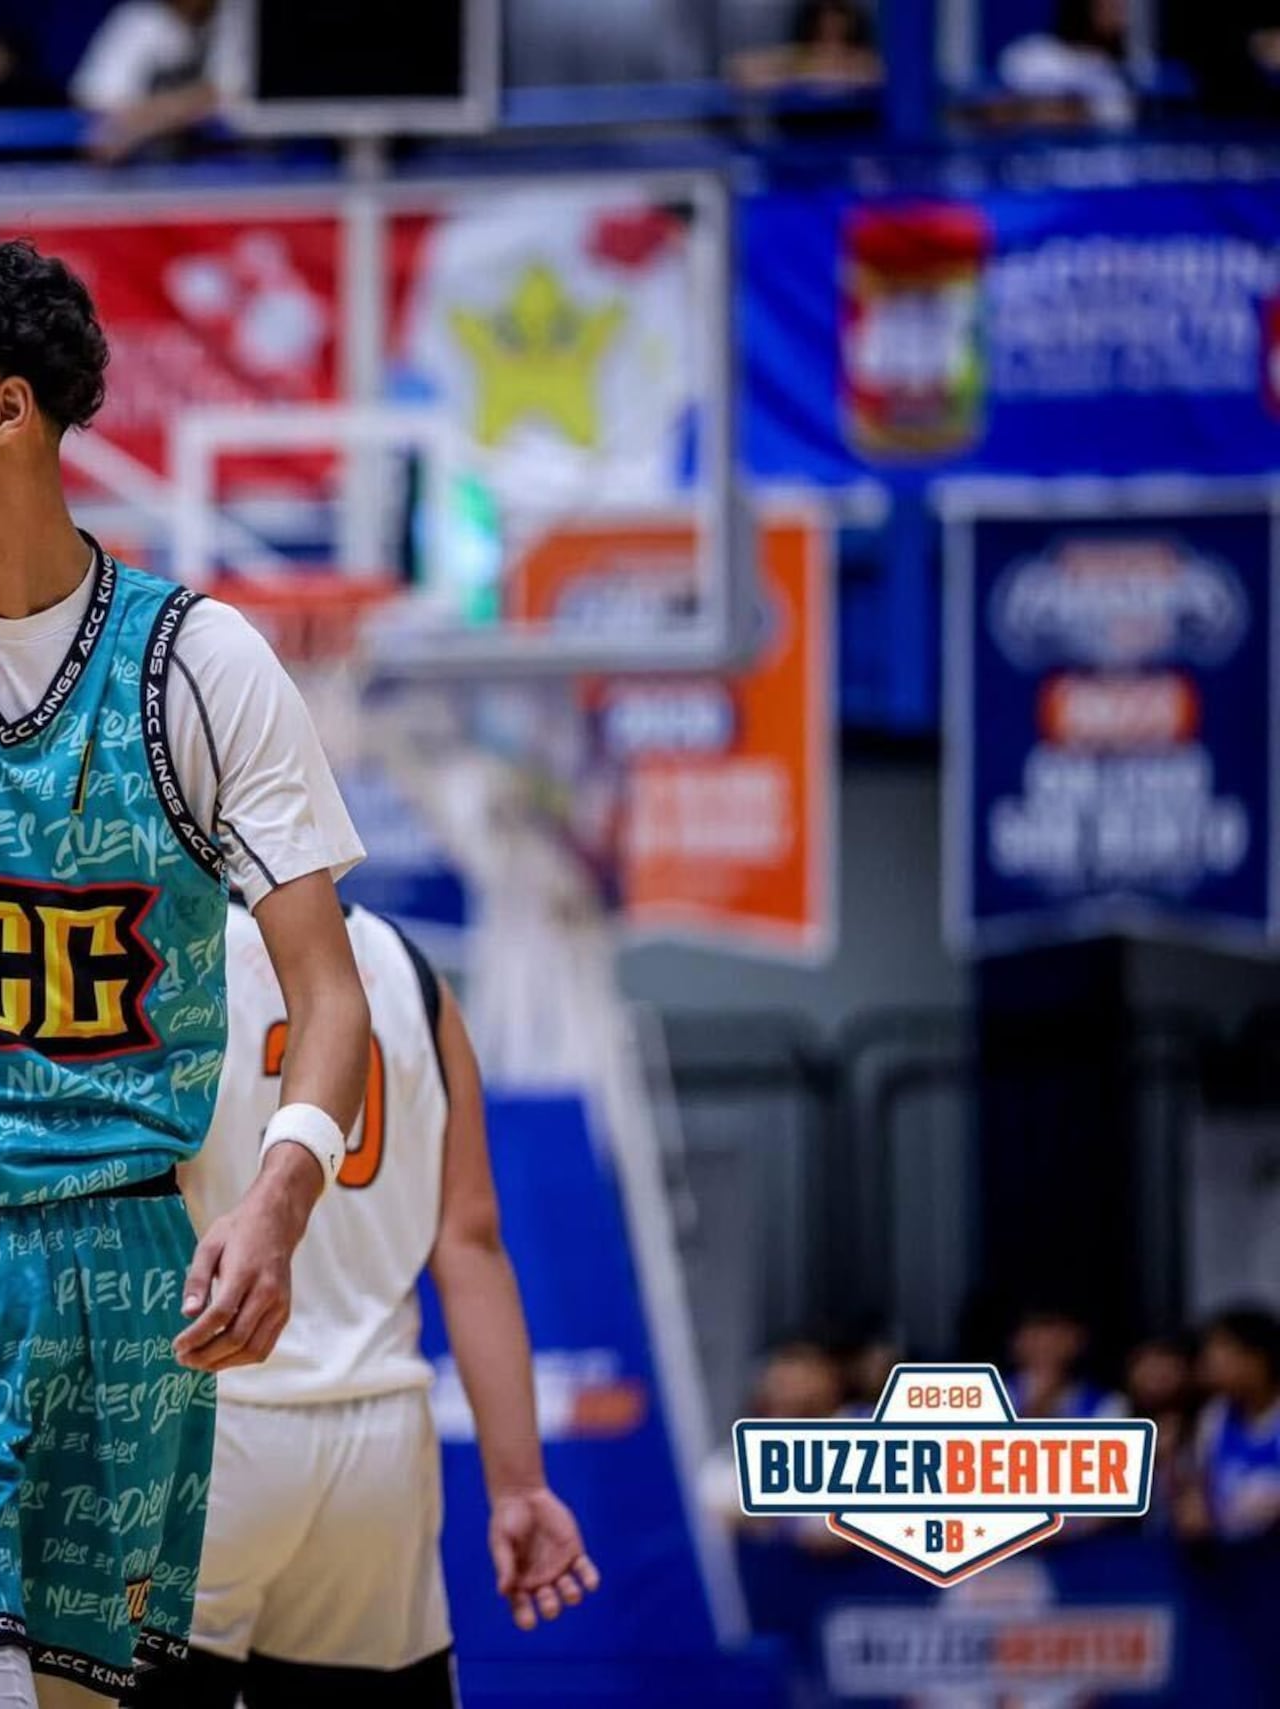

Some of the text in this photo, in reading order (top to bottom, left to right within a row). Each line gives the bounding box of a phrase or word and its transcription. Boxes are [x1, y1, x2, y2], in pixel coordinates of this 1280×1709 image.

[32, 660, 82, 727] KINGS
[79, 608, 106, 657] ACC
[150, 608, 181, 675] KINGS
[146, 682, 161, 735] ACC
[149, 741, 185, 816] KINGS
[178, 821, 218, 861] ACC
[38, 1650, 89, 1674] ACC
